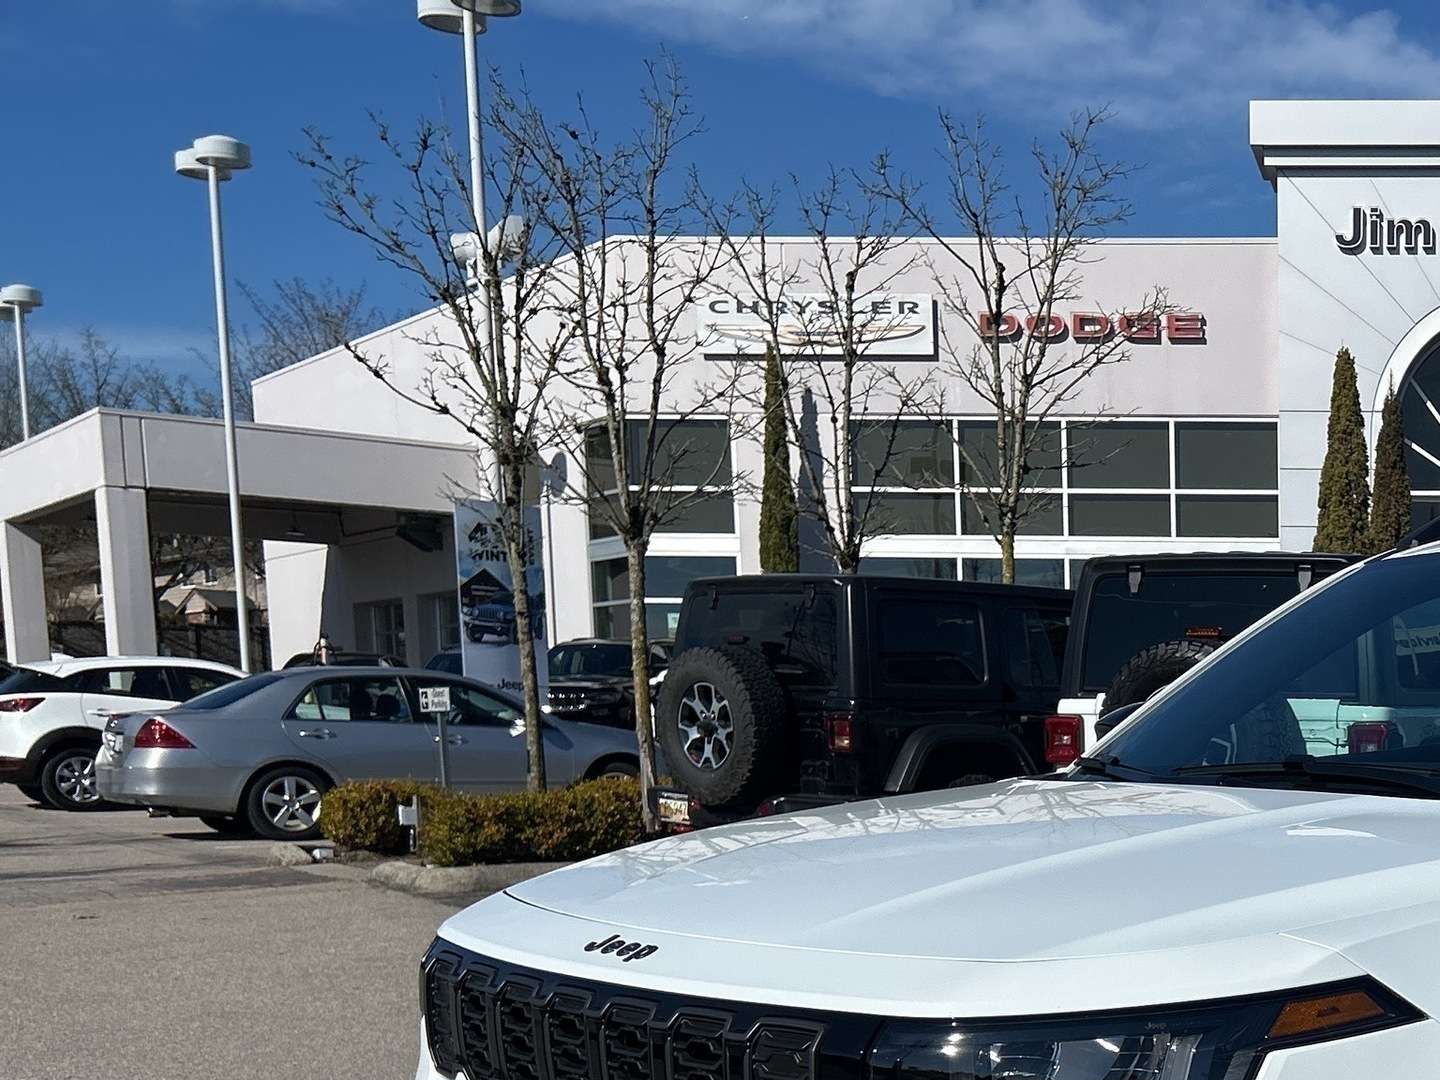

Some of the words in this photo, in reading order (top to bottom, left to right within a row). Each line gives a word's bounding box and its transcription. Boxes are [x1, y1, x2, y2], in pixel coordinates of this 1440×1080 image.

[1335, 205, 1437, 255] Jim
[977, 311, 1207, 345] DODGE
[583, 934, 659, 963] Jeep
